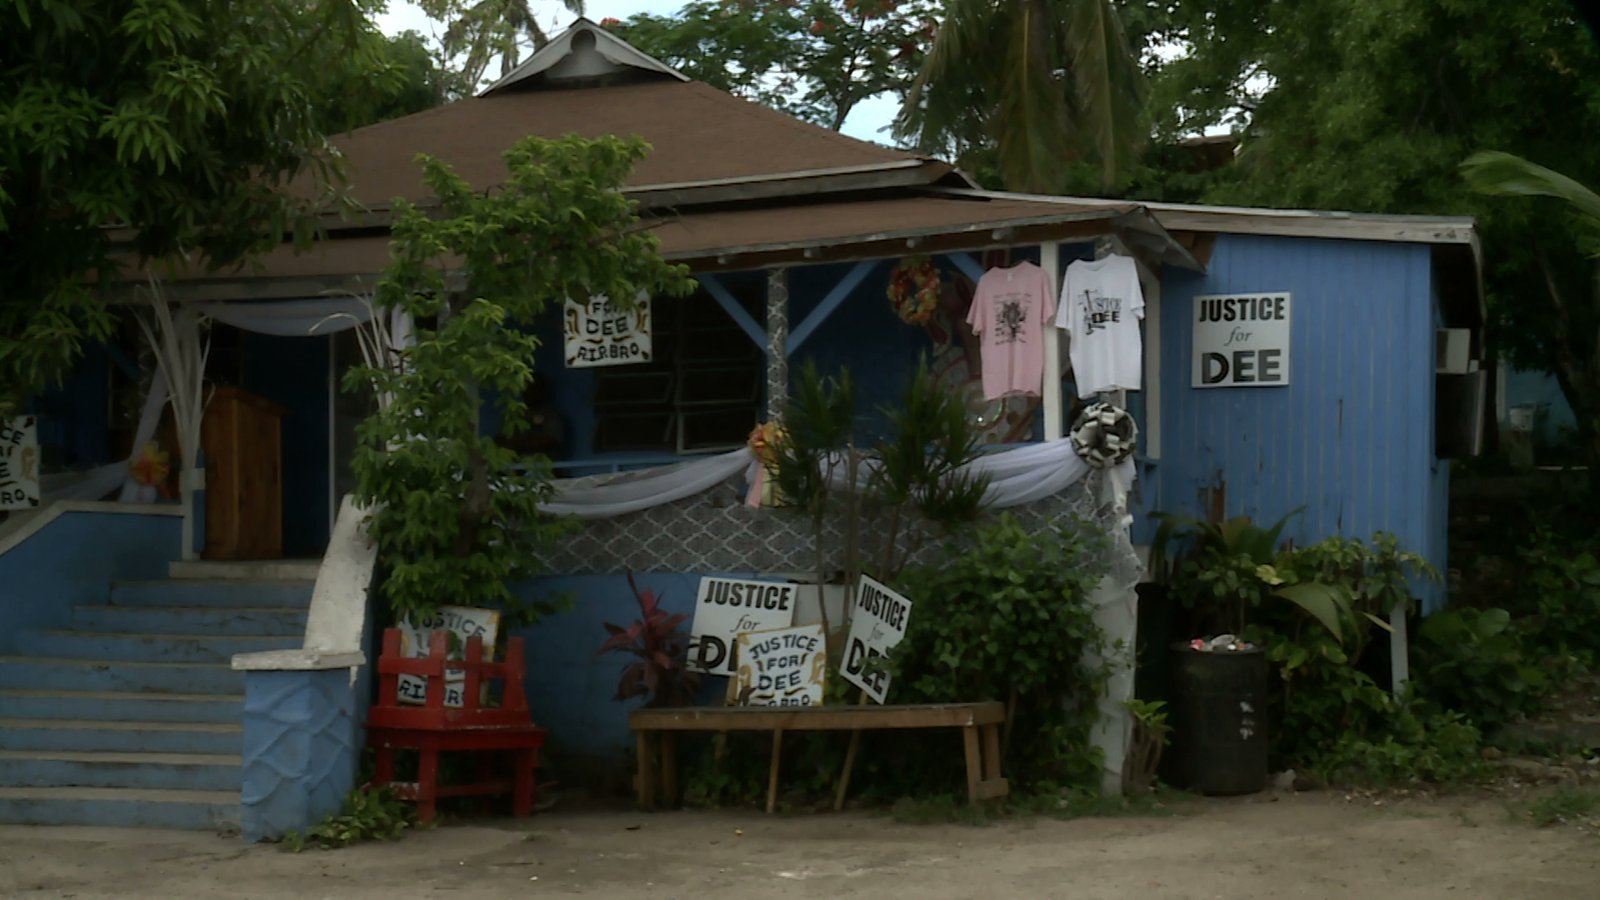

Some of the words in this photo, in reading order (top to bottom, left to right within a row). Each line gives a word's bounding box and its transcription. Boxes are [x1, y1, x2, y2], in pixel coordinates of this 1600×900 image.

[592, 302, 617, 314] FO
[1198, 297, 1285, 322] JUSTICE
[586, 317, 628, 335] DEE
[1223, 326, 1253, 347] for
[1201, 349, 1282, 384] DEE
[704, 580, 791, 611] JUSTICE
[859, 583, 906, 631] JUSTICE
[730, 614, 760, 633] for
[749, 634, 819, 659] JUSTICE
[767, 655, 799, 670] FOR
[759, 670, 801, 690] DEE
